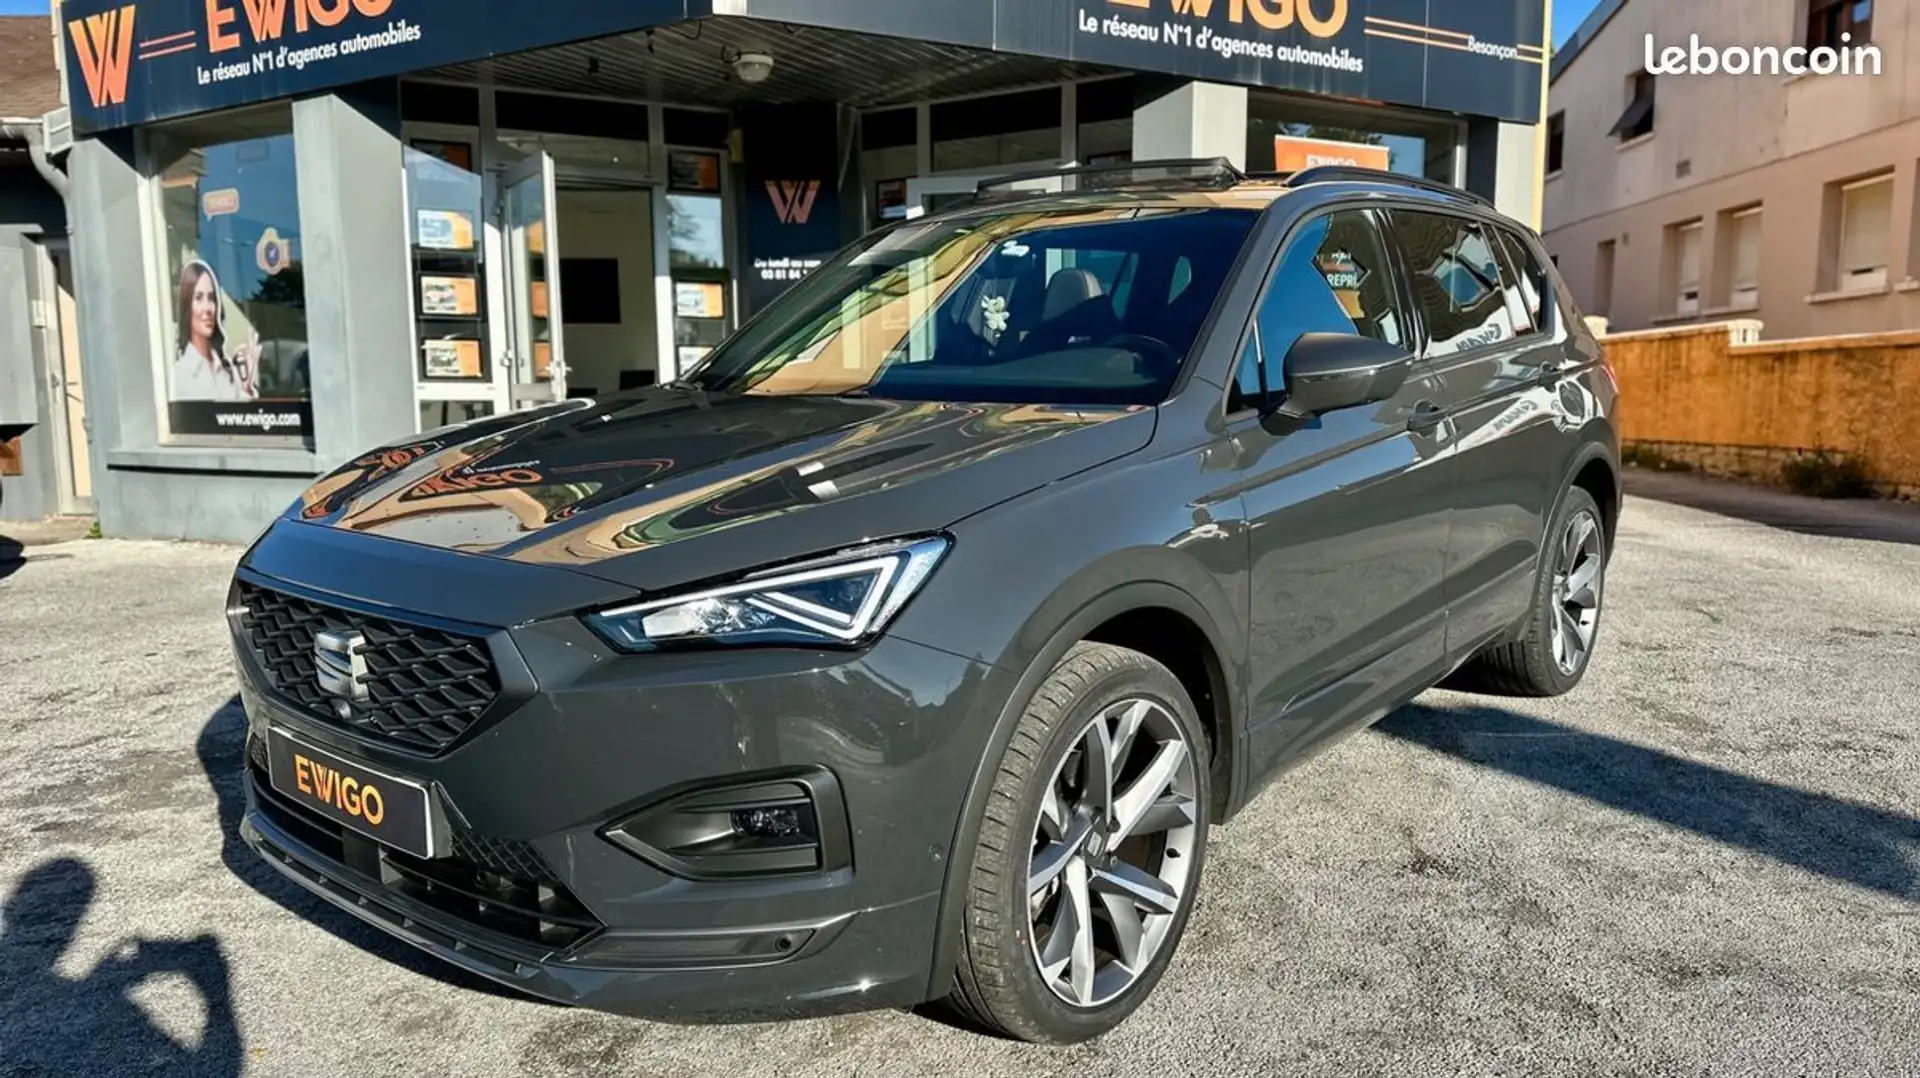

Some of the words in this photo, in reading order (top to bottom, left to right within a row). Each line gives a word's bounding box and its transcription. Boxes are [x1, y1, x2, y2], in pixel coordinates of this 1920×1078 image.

[196, 66, 210, 85] Le
[212, 60, 250, 81] réseau
[340, 19, 421, 51] automobiles
[206, 0, 392, 53] EWI
[1079, 9, 1098, 33] Le
[1103, 14, 1158, 42] réseau
[1277, 44, 1364, 73] automobiles
[1468, 34, 1518, 60] Besançon
[216, 408, 301, 431] www.ewigo.com
[294, 754, 384, 825] EWIGO
